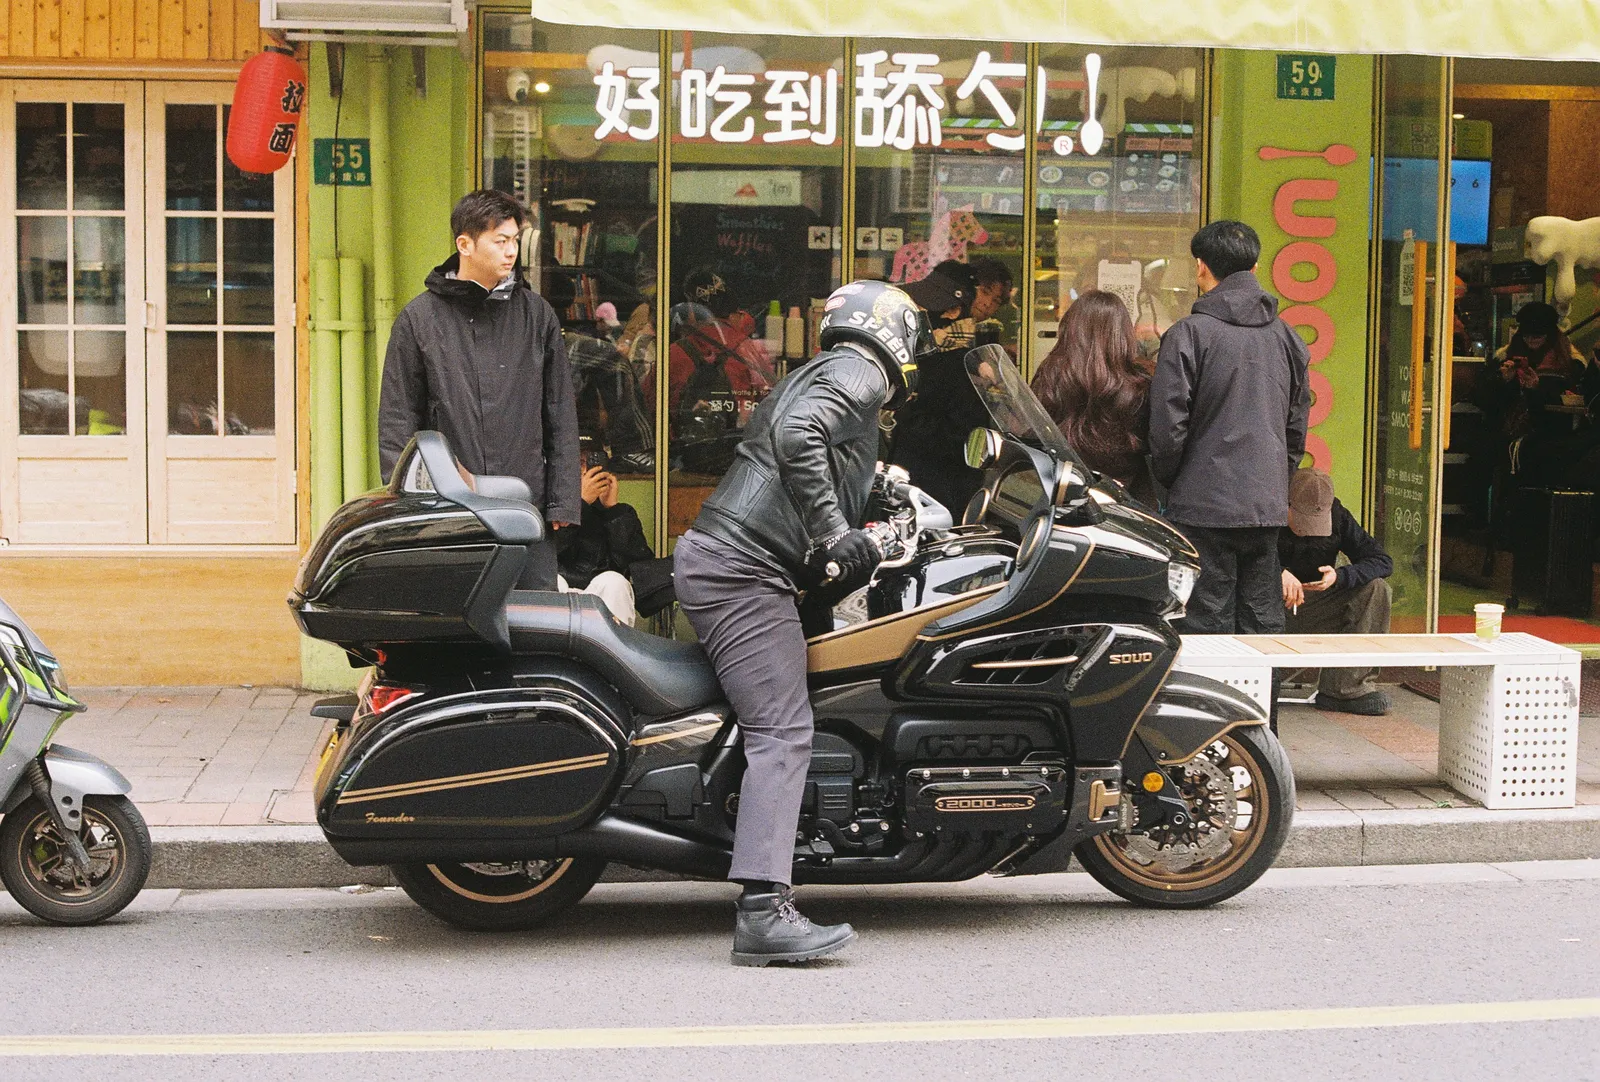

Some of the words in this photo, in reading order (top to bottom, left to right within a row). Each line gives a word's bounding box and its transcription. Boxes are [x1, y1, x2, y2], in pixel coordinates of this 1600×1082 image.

[1292, 61, 1321, 84] 59
[268, 80, 305, 154] 拉面
[332, 144, 363, 169] 55
[848, 311, 910, 364] SPEED
[946, 799, 996, 808] 2000
